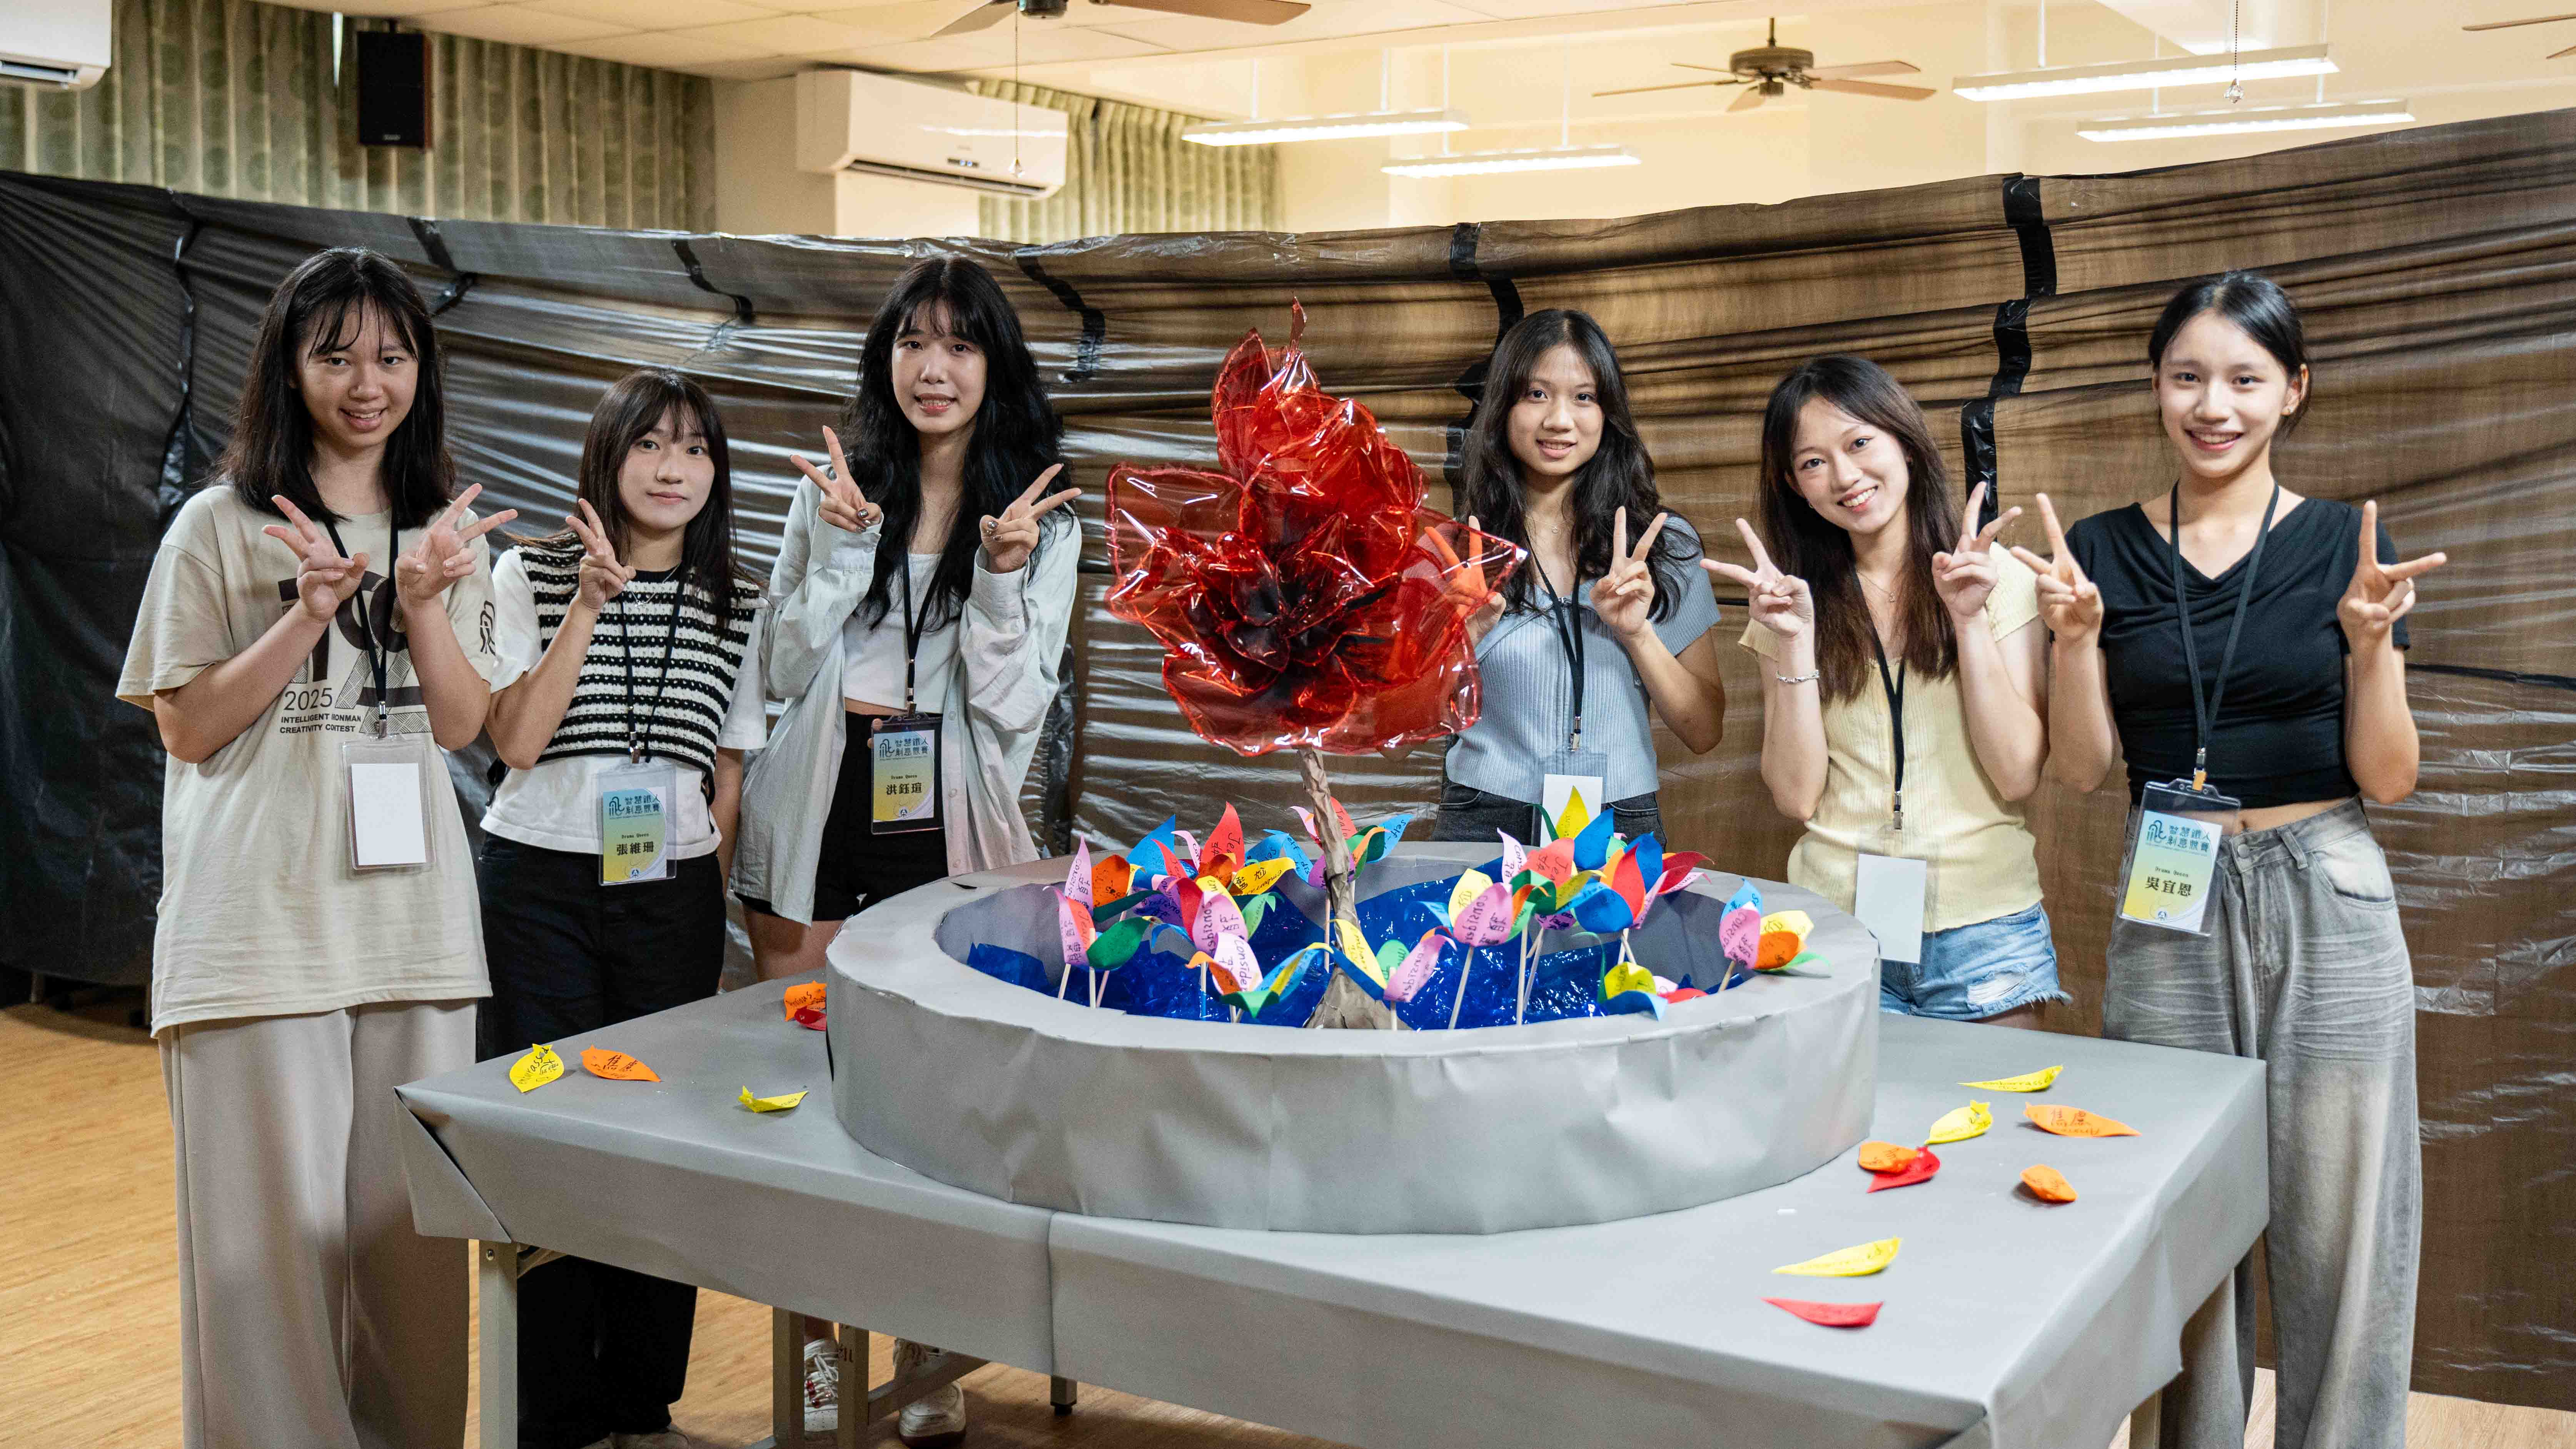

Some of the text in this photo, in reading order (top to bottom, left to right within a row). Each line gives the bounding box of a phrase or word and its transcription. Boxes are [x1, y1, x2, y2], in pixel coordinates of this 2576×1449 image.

[284, 688, 333, 711] 2025
[281, 713, 361, 723] INTELLIGENT IRONMAN
[280, 724, 323, 733] CREATIVITY
[2145, 876, 2192, 896] 吳宜恩
